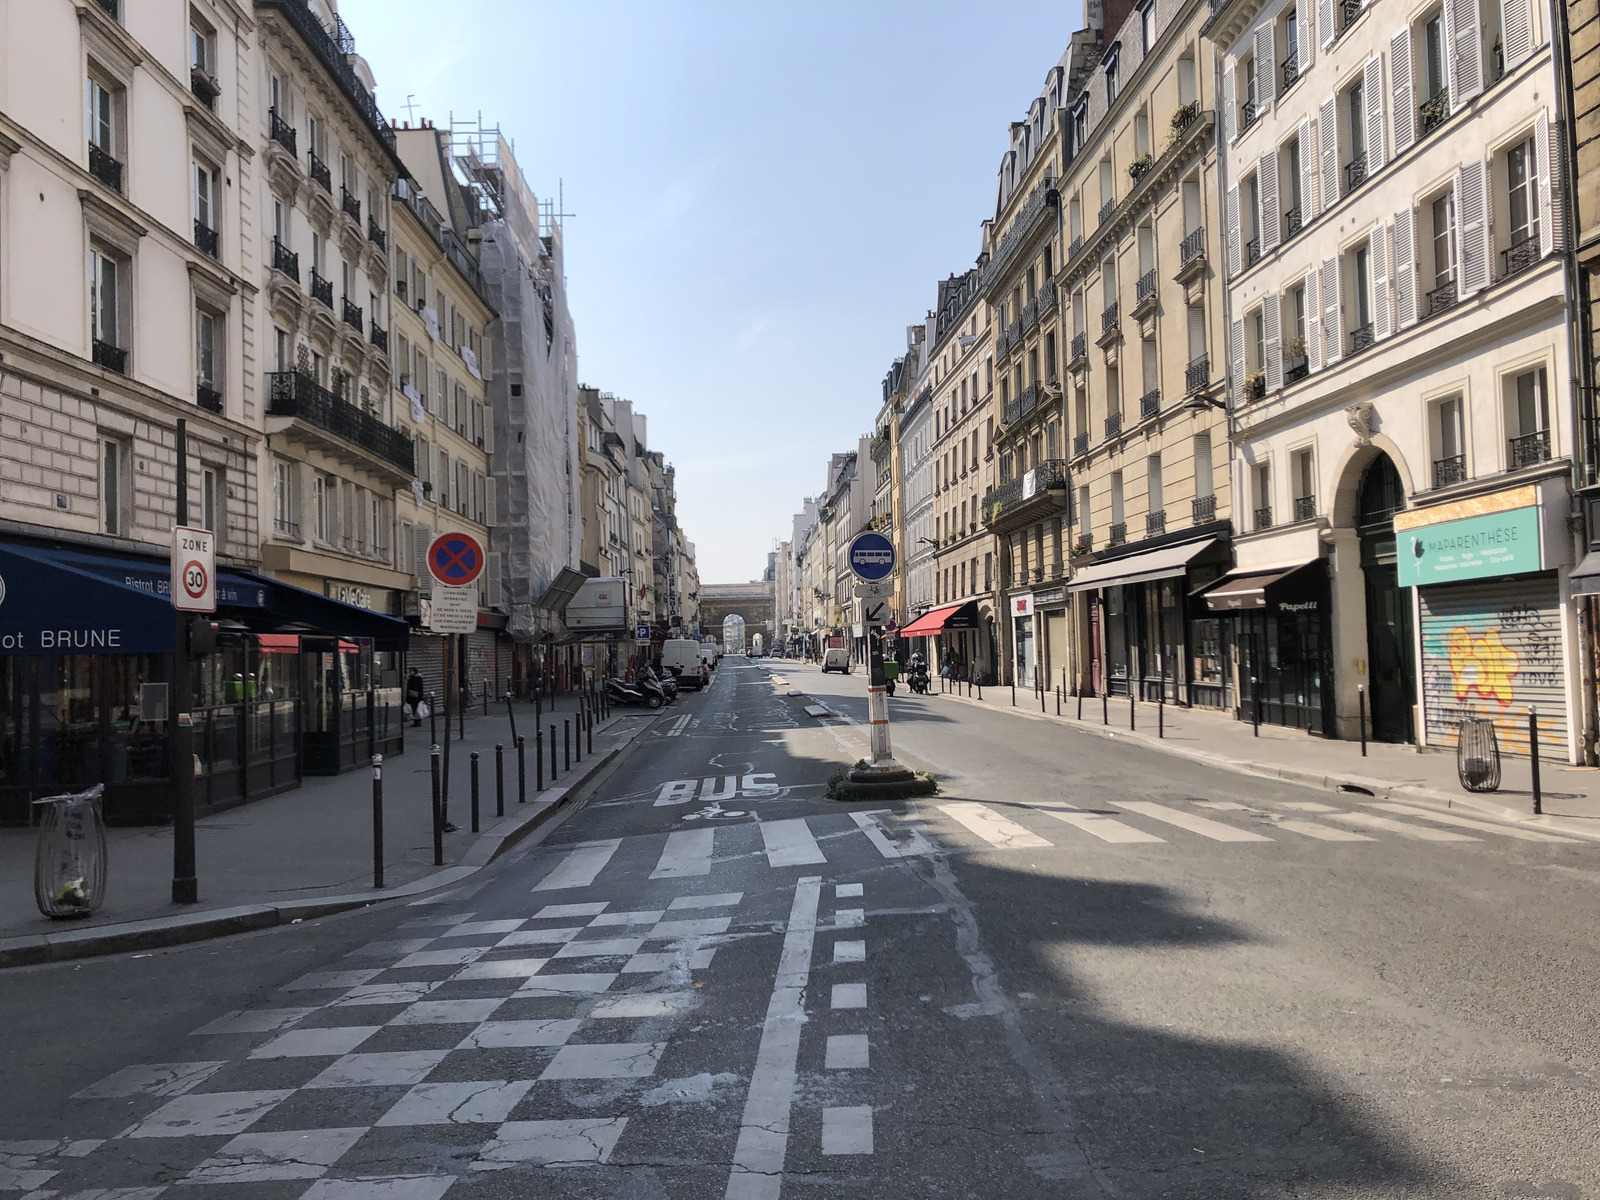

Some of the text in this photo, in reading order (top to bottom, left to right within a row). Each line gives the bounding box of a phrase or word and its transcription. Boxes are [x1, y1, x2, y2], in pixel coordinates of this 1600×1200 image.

[182, 538, 208, 553] ZONE
[1428, 526, 1519, 553] MAPARENTHÈSE
[125, 576, 154, 593] Bistrot
[188, 570, 203, 588] 30
[1279, 601, 1318, 612] Papelli
[0, 629, 121, 649] ot BRUNE
[640, 628, 647, 637] P
[652, 772, 779, 807] BUS
